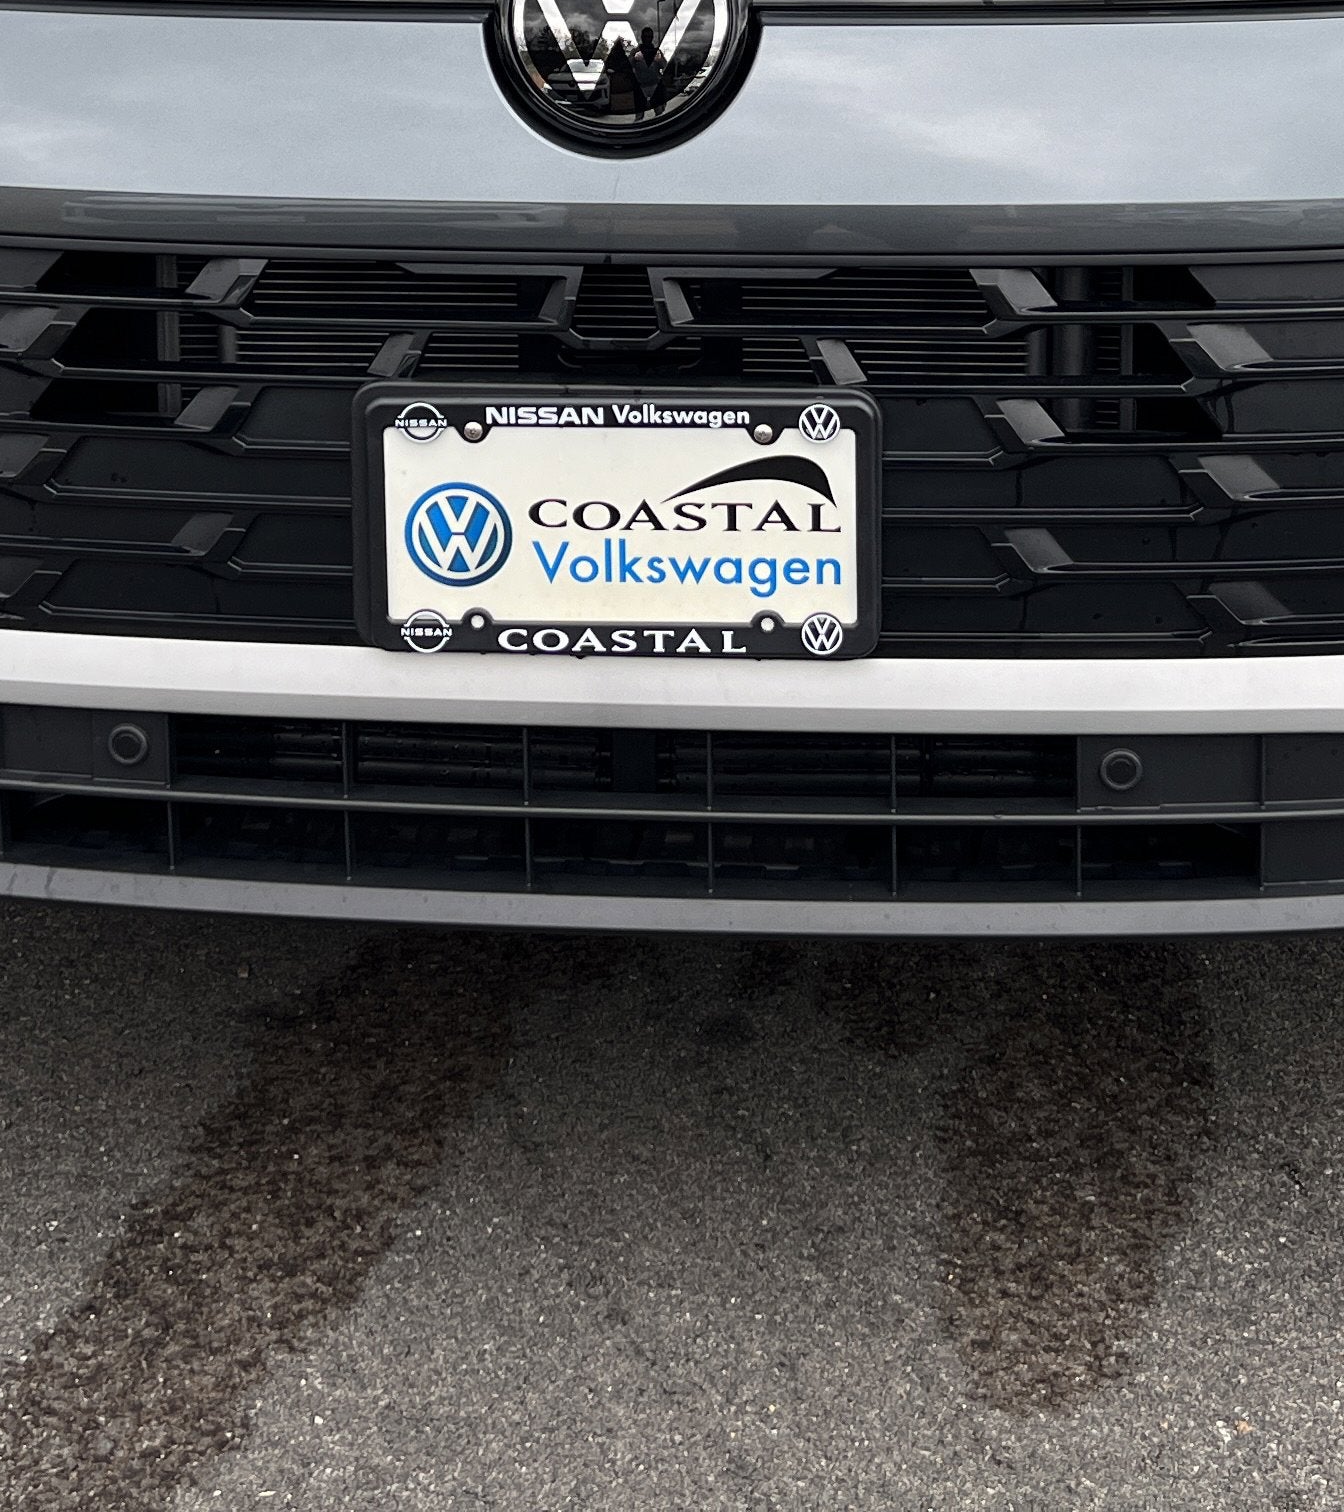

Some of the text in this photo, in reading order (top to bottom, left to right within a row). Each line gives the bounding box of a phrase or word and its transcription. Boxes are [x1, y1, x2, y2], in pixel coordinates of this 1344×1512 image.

[394, 418, 448, 428] NISSAN
[485, 404, 750, 427] NISSAN Volkswagen
[528, 499, 842, 533] COASTAL
[532, 539, 841, 597] Volkswagen
[400, 626, 453, 637] NISSAN
[497, 628, 747, 653] COASTAL
